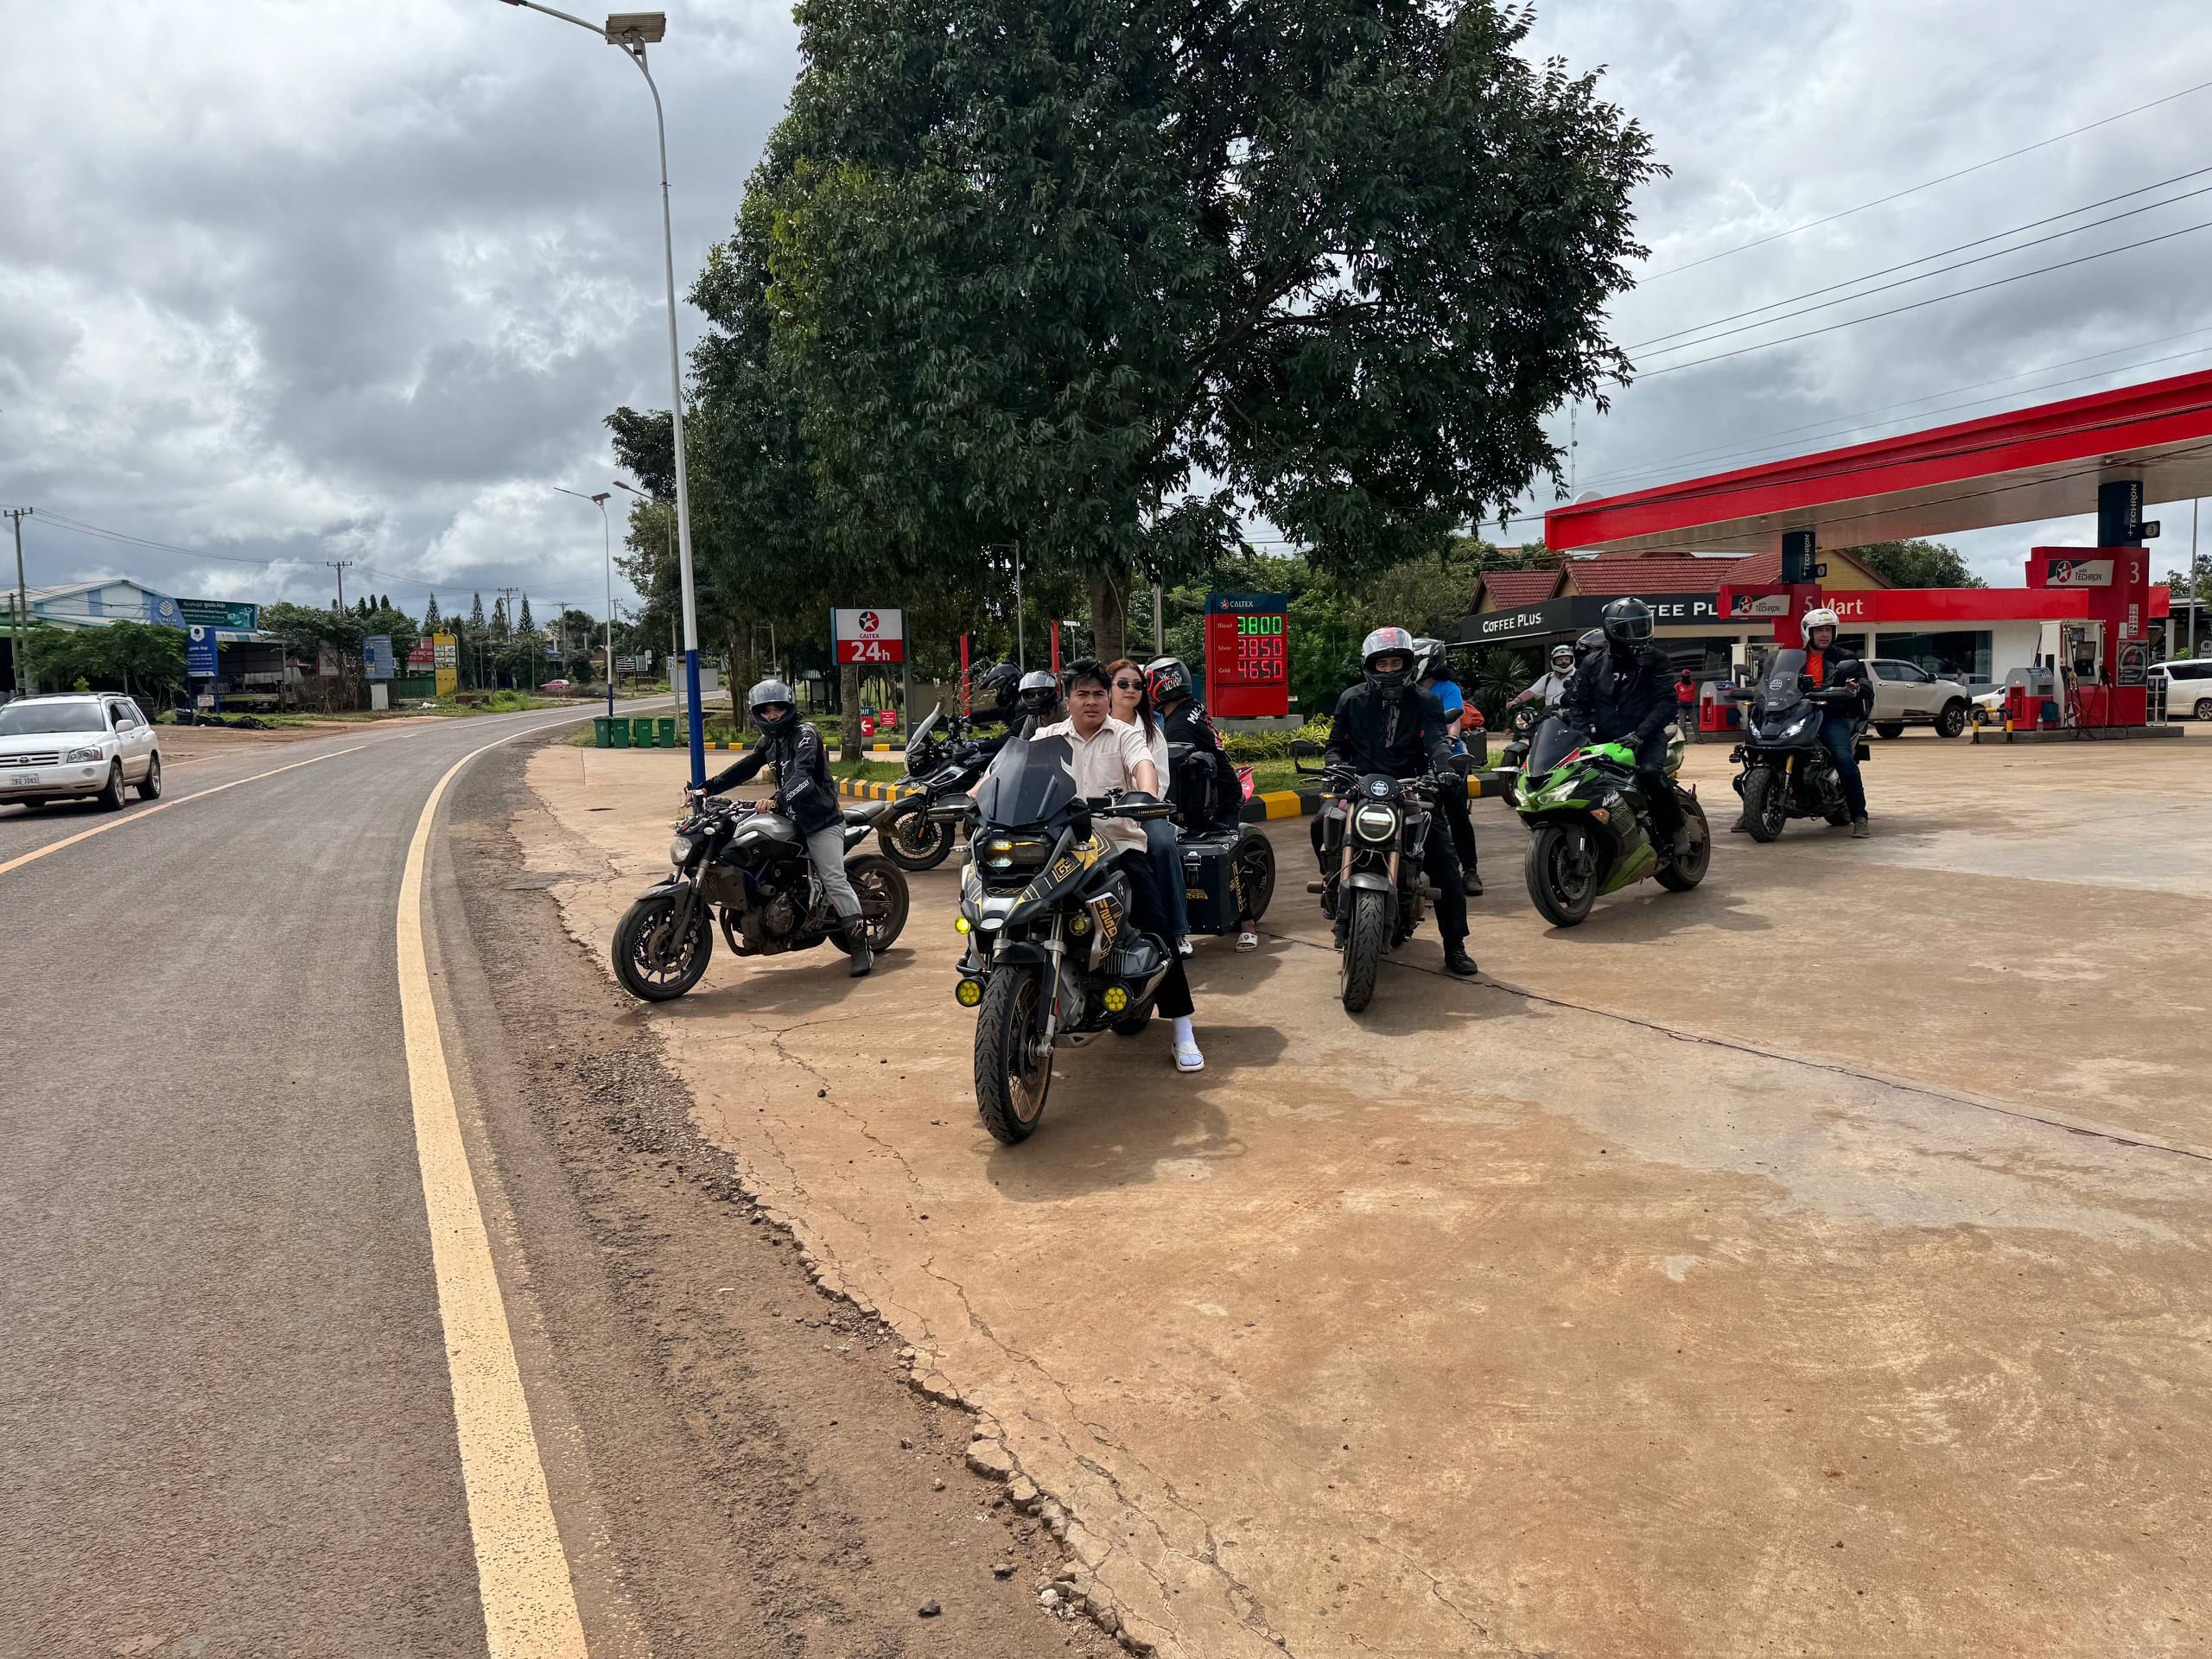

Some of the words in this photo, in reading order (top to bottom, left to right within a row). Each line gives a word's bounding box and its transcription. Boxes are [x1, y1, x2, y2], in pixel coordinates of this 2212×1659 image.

[2149, 525, 2154, 534] 3
[2075, 572, 2102, 582] TECHRON
[2129, 561, 2140, 584] 3
[1237, 616, 1282, 635] 3800
[1483, 617, 1515, 632] COFFEE
[1517, 613, 1541, 627] PLUS
[851, 641, 891, 661] 24h
[1238, 639, 1282, 657] 3850
[1237, 660, 1282, 678] 4650
